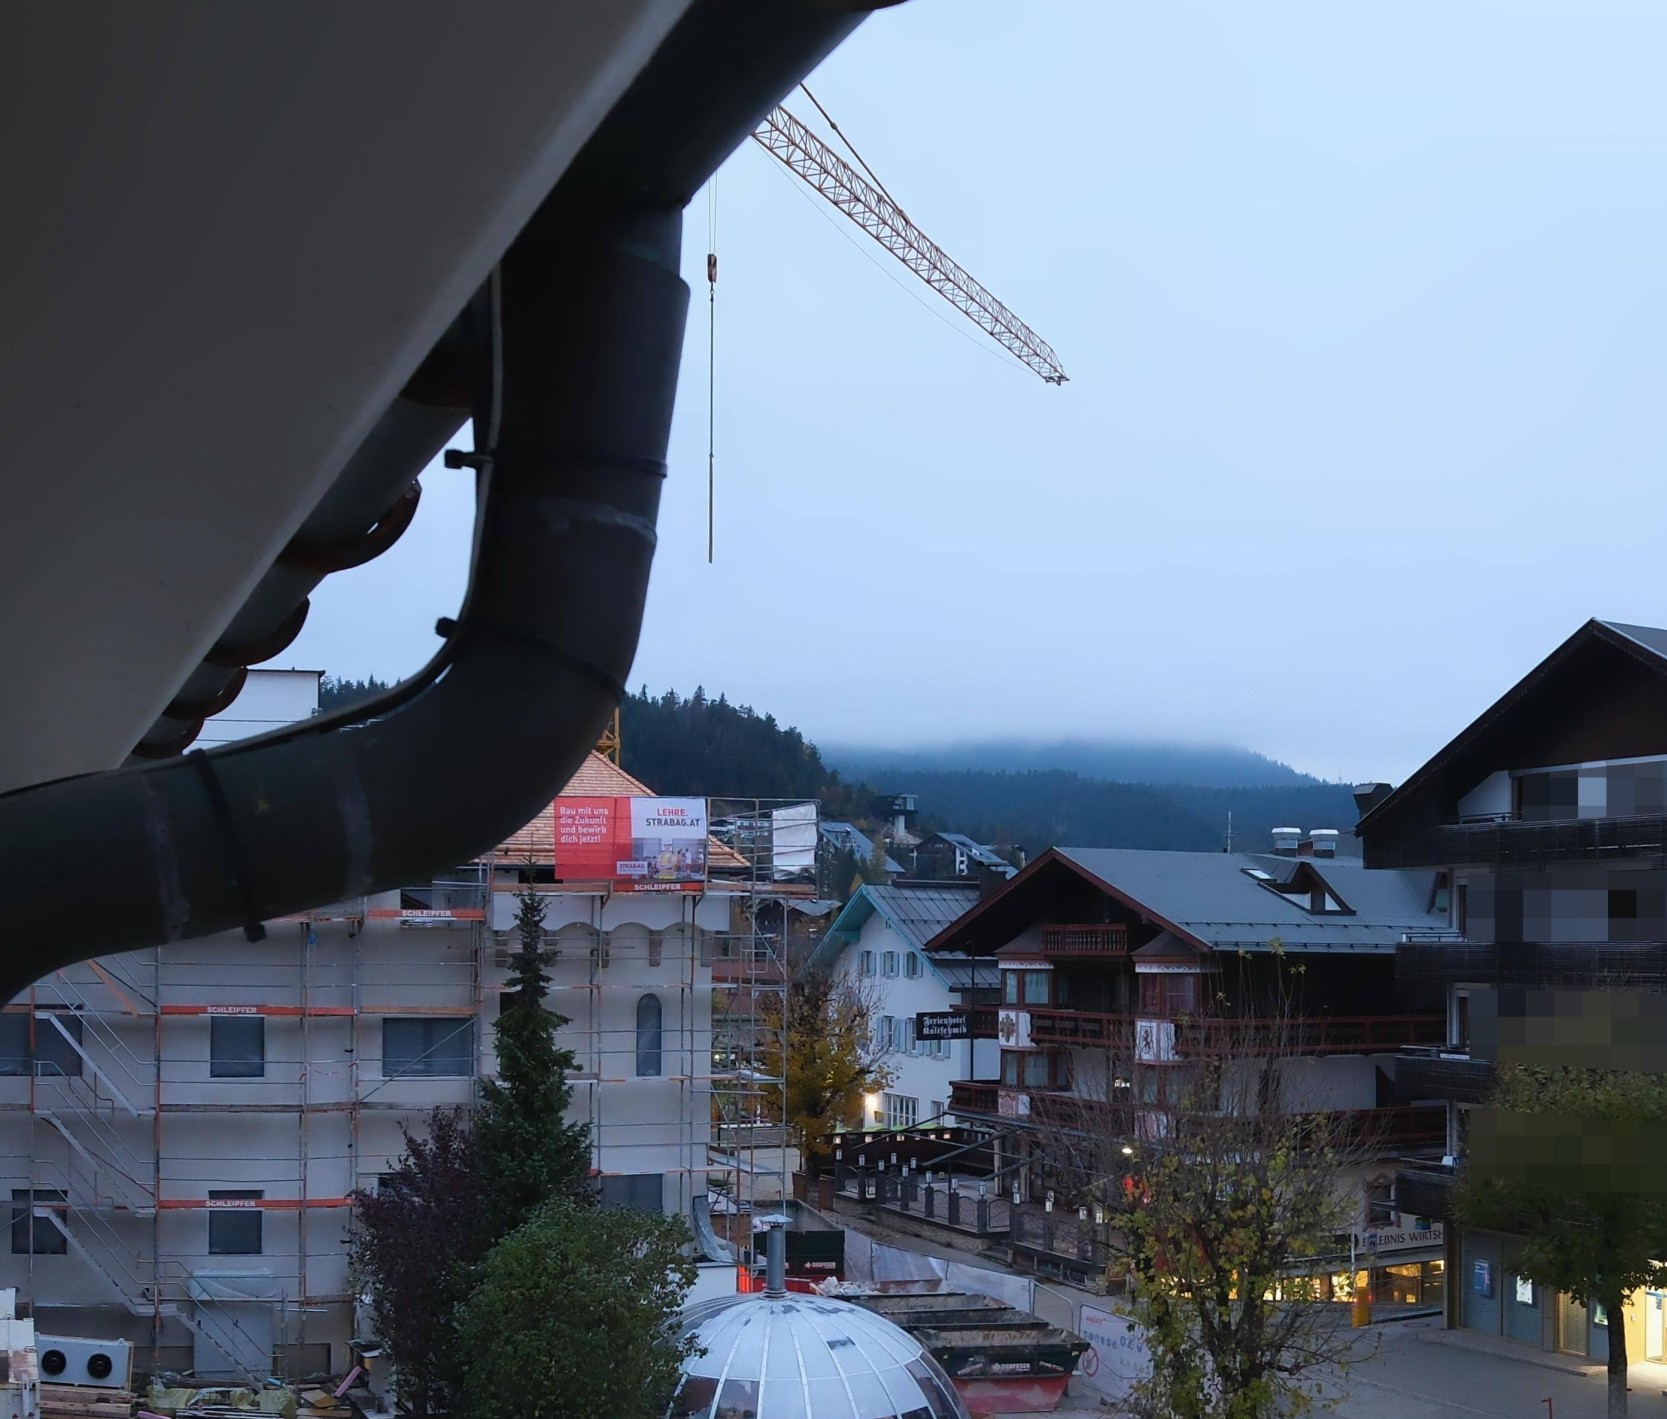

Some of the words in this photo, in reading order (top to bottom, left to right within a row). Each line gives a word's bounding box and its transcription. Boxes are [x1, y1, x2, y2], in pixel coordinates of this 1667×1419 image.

[560, 807, 575, 815] Bau
[578, 807, 591, 815] mit
[657, 808, 688, 817] LEHRE.
[560, 816, 572, 824] die
[574, 816, 606, 824] Zukunft
[645, 818, 701, 827] STRABAG.AT
[560, 825, 575, 834] und
[578, 825, 606, 834] bewirb
[560, 835, 577, 843] dich
[579, 835, 601, 845] jetzt!
[634, 883, 681, 891] SCHLEIPFER
[402, 909, 452, 917] SCHLEIPFER
[206, 1006, 257, 1014] SCHLEIPFER
